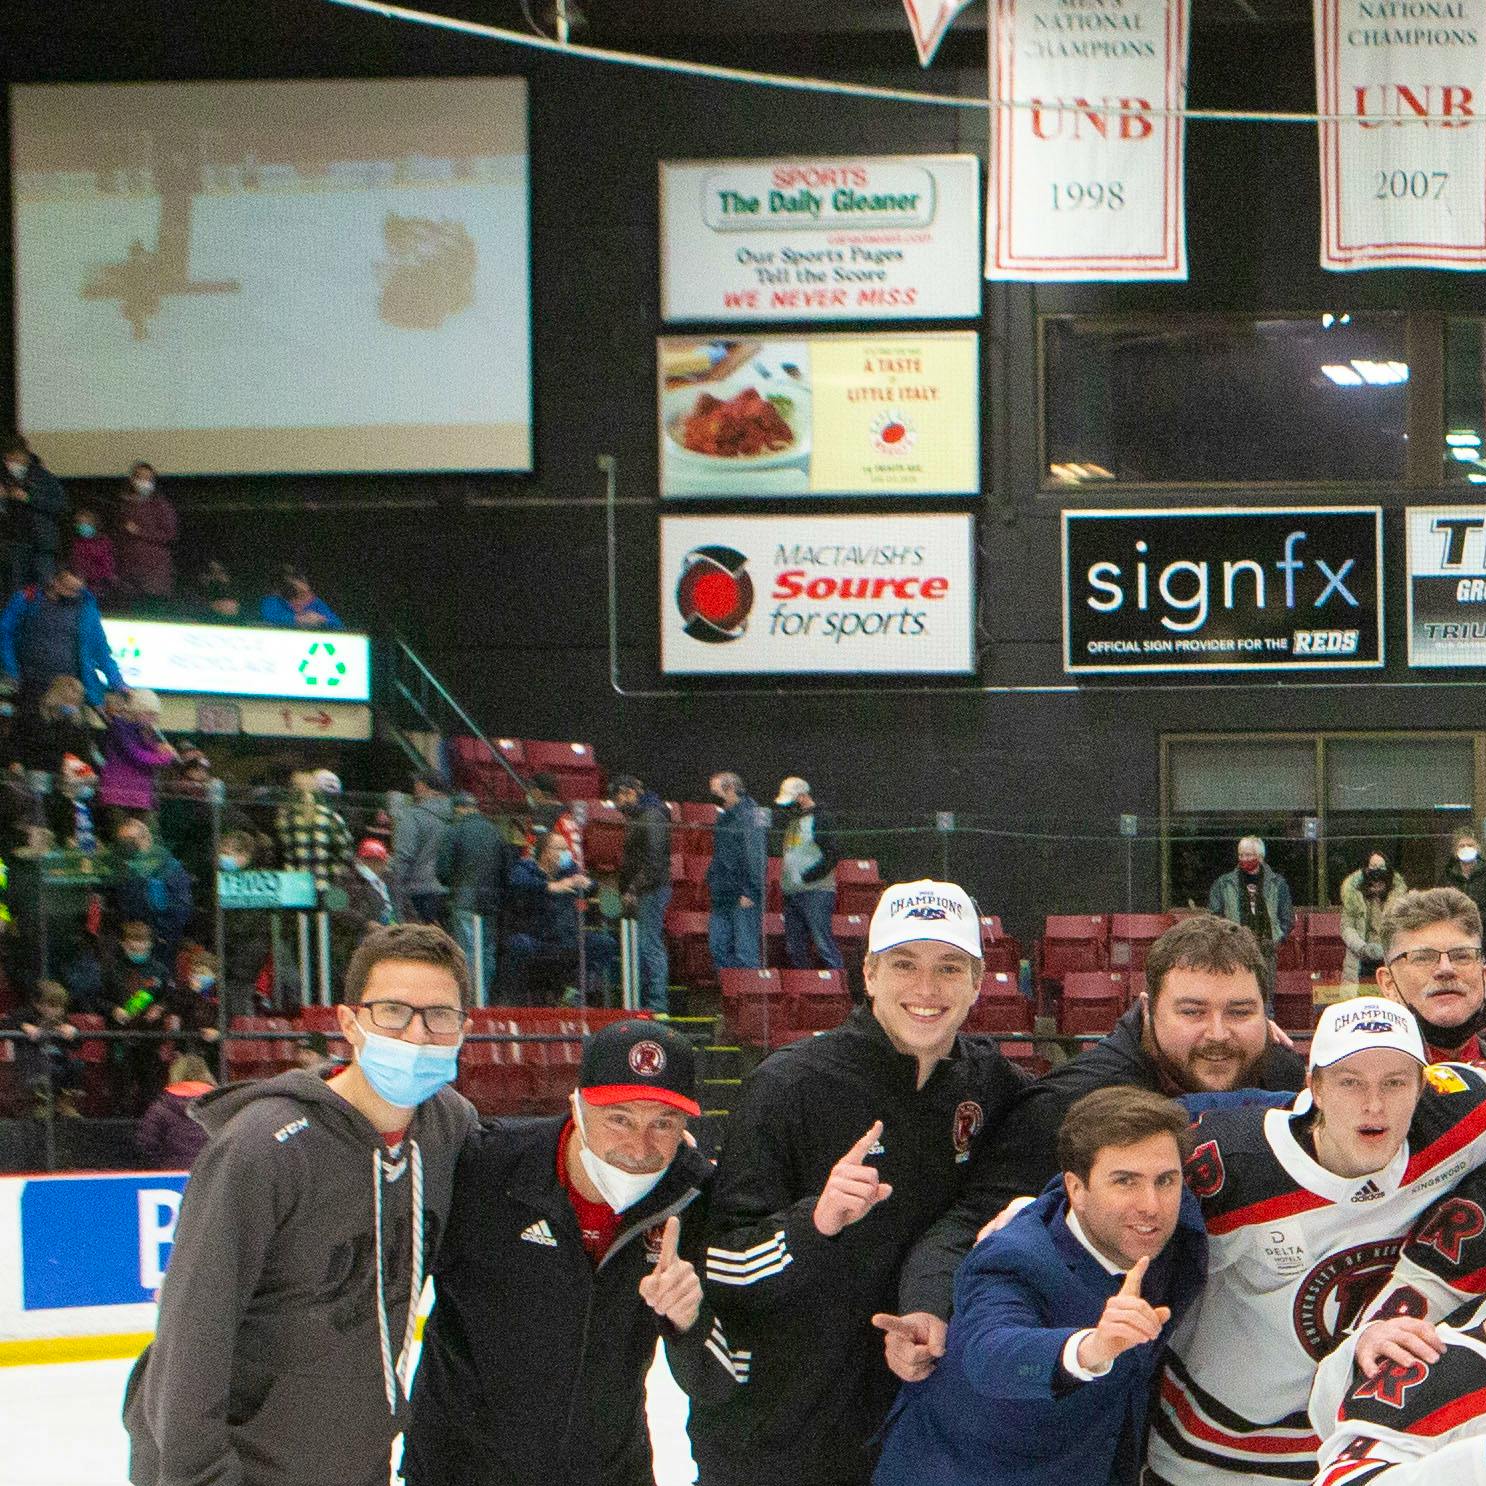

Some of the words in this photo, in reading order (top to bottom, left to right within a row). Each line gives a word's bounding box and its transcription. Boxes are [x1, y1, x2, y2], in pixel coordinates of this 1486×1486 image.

[1357, 3, 1467, 20] NATIONAL
[1347, 28, 1479, 49] CHAMPIONS
[1030, 97, 1153, 142] UNB
[1353, 84, 1475, 130] UNB
[772, 166, 869, 188] SPORTS
[1375, 170, 1450, 200] 2007
[717, 189, 760, 214] The
[767, 188, 821, 220] Daily
[832, 188, 921, 212] Gleaner
[1051, 182, 1125, 211] 1998
[736, 247, 774, 264] Our
[780, 247, 843, 268] Sports
[850, 247, 904, 268] Pages
[755, 267, 789, 283] Tell
[796, 266, 827, 283] the
[832, 267, 888, 283] Score
[723, 290, 759, 309] WE
[770, 289, 848, 309] NEVER
[856, 287, 918, 307] MISS
[877, 358, 924, 373] TASTE
[846, 386, 895, 402] LITTLE
[898, 386, 939, 402] ITALY
[773, 543, 925, 566] MACTAVISH'S
[771, 569, 950, 600] Source
[1086, 530, 1360, 633] signfx
[768, 603, 819, 636] for
[821, 606, 929, 644] sports
[1086, 640, 1142, 654] OFFICIAL
[1143, 639, 1173, 652] SIGN
[1174, 638, 1236, 652] PROVIDER
[1237, 638, 1262, 651] FOR
[1263, 637, 1289, 650] THE
[1291, 630, 1360, 654] REDS
[890, 893, 963, 920] CHAMPIONS
[1334, 1009, 1409, 1034] CHAMPIONS
[1411, 1160, 1468, 1195] KINGSWOOD
